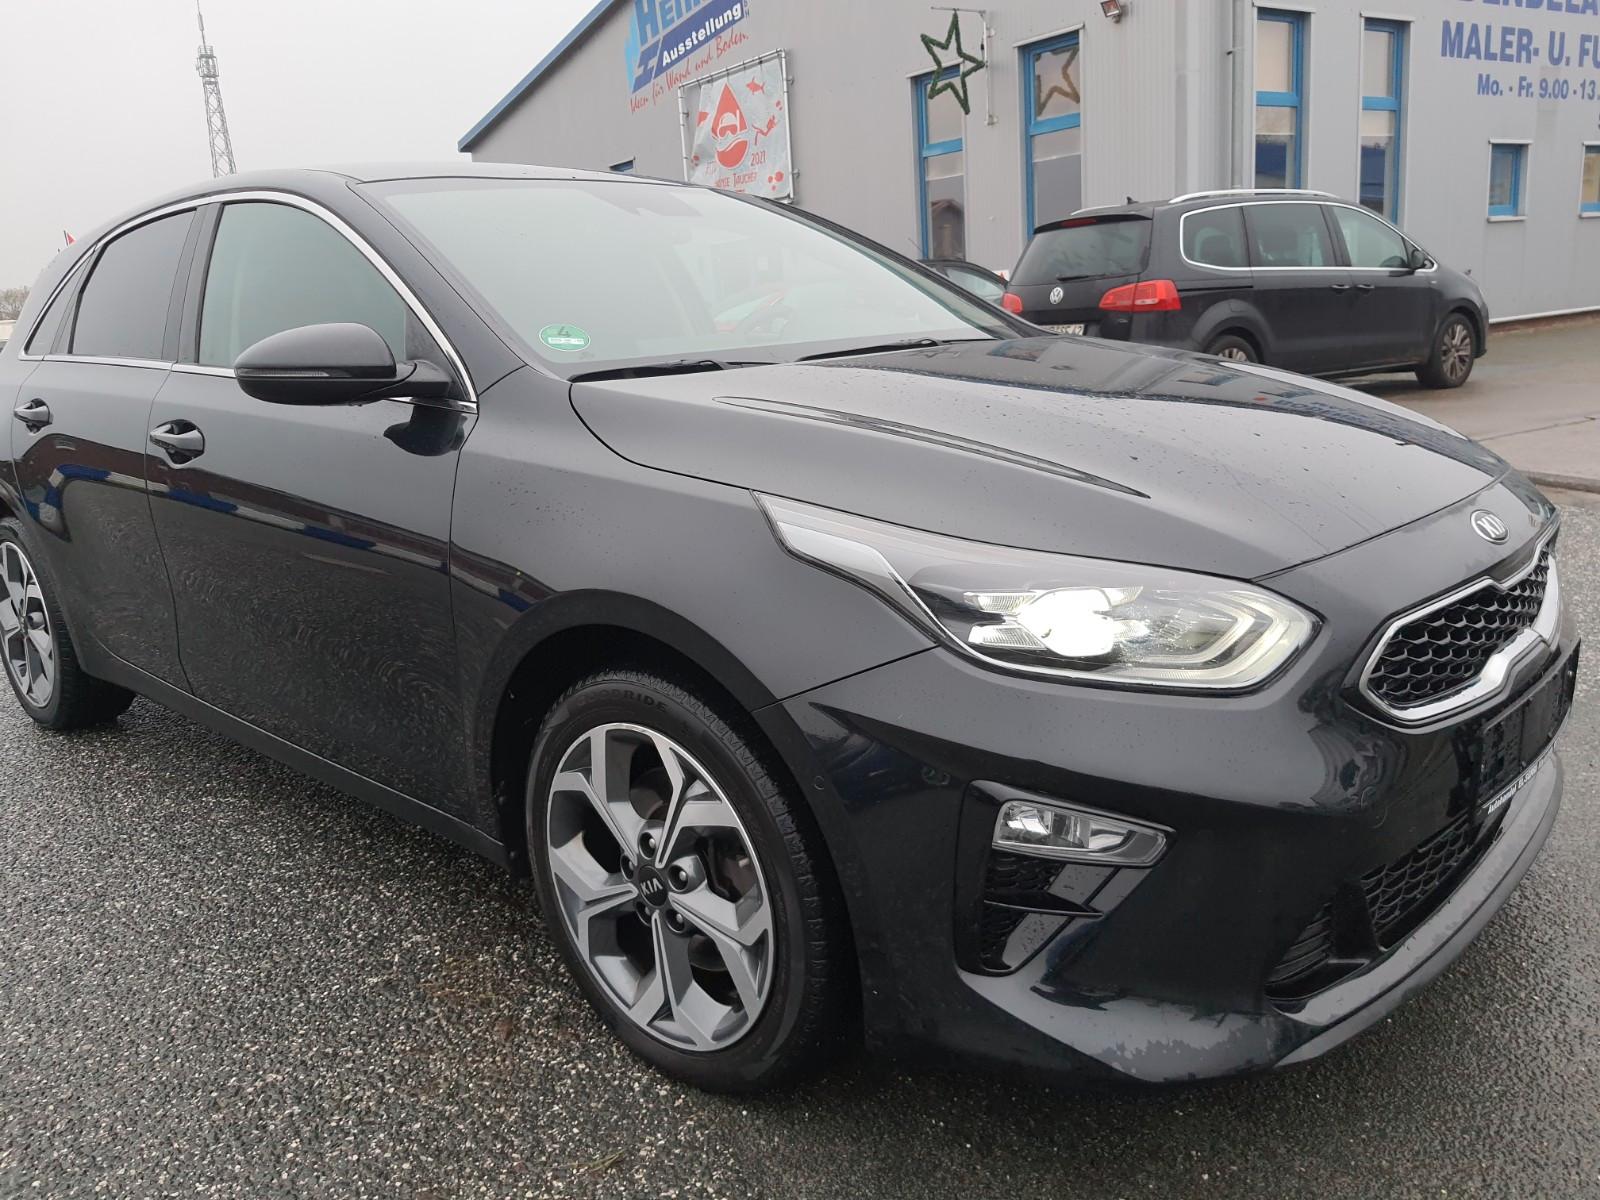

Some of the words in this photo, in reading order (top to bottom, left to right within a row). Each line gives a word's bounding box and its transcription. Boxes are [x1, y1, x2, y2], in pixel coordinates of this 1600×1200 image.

[662, 2, 742, 67] Ausstellung
[1440, 19, 1540, 64] MALER-
[1548, 30, 1571, 67] U.
[665, 56, 692, 91] Wand
[694, 46, 713, 70] und
[1477, 73, 1503, 97] Mo.
[1517, 76, 1534, 98] Fr.
[750, 150, 767, 167] 2021
[640, 877, 663, 896] KIA
